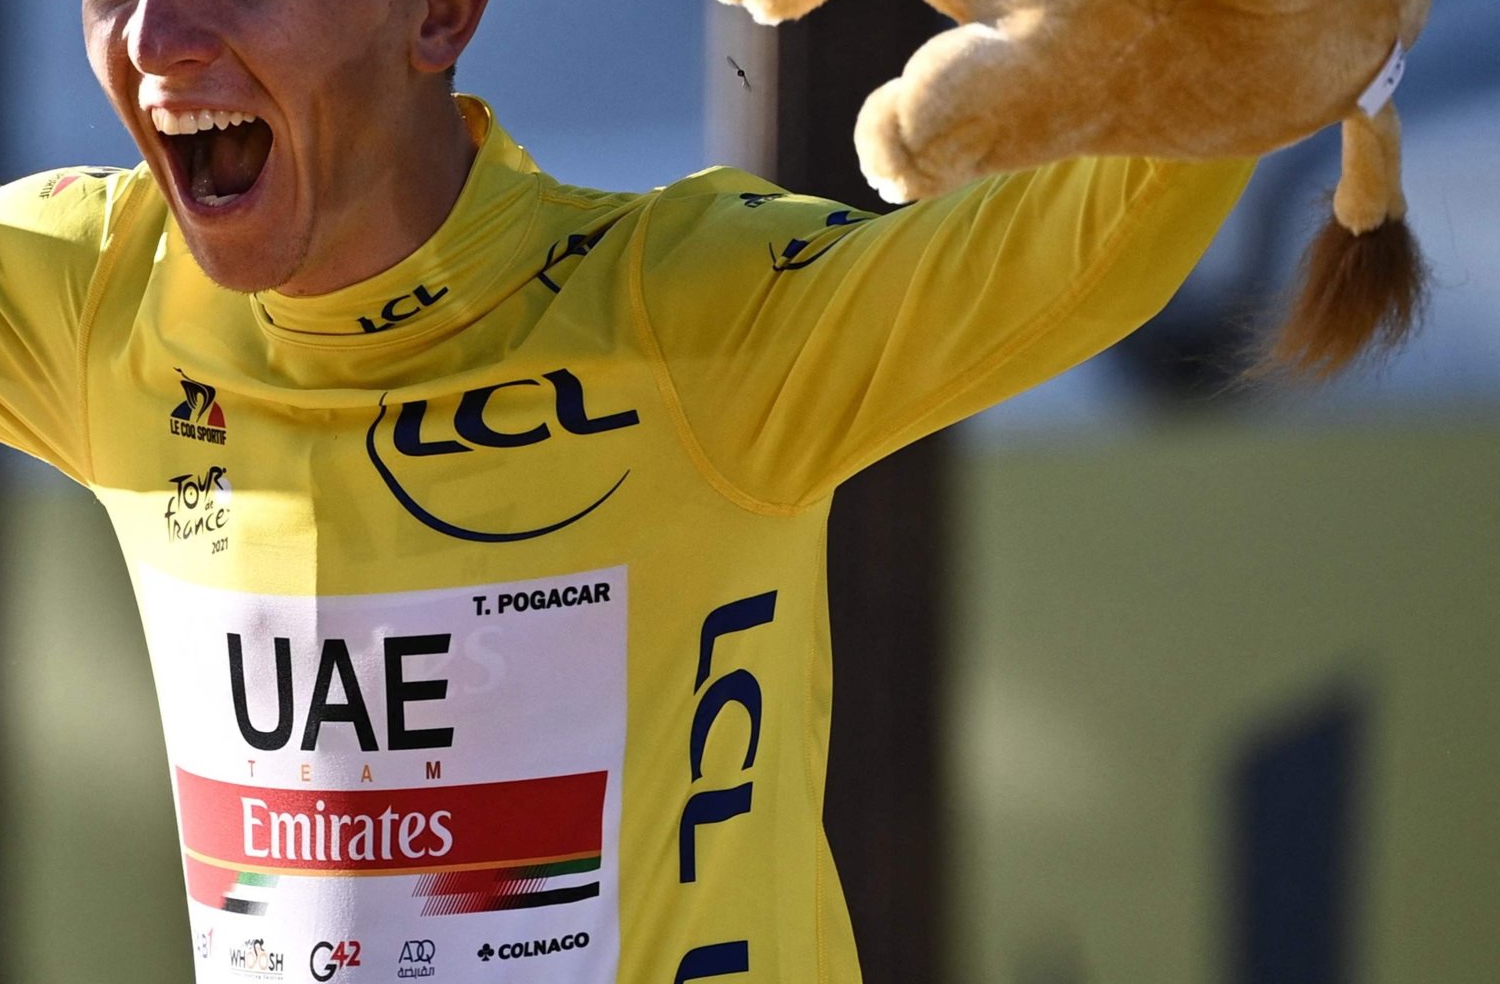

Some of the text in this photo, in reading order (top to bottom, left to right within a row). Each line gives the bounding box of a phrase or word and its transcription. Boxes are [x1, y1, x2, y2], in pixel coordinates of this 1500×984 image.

[357, 284, 450, 334] LCL
[393, 367, 640, 457] LCL
[169, 418, 227, 446] LE COQ SPORTIF
[168, 466, 227, 511] TOUR
[211, 537, 229, 555] 2021
[473, 582, 611, 616] T. POGACAR
[226, 632, 455, 753] UAE
[679, 589, 779, 884] LCL
[247, 759, 442, 784] TEAM
[240, 796, 455, 862] Emirates
[230, 948, 284, 972] WHOOSH
[310, 940, 362, 983] G42
[398, 939, 436, 965] ADQ
[497, 932, 591, 961] COLNAGO
